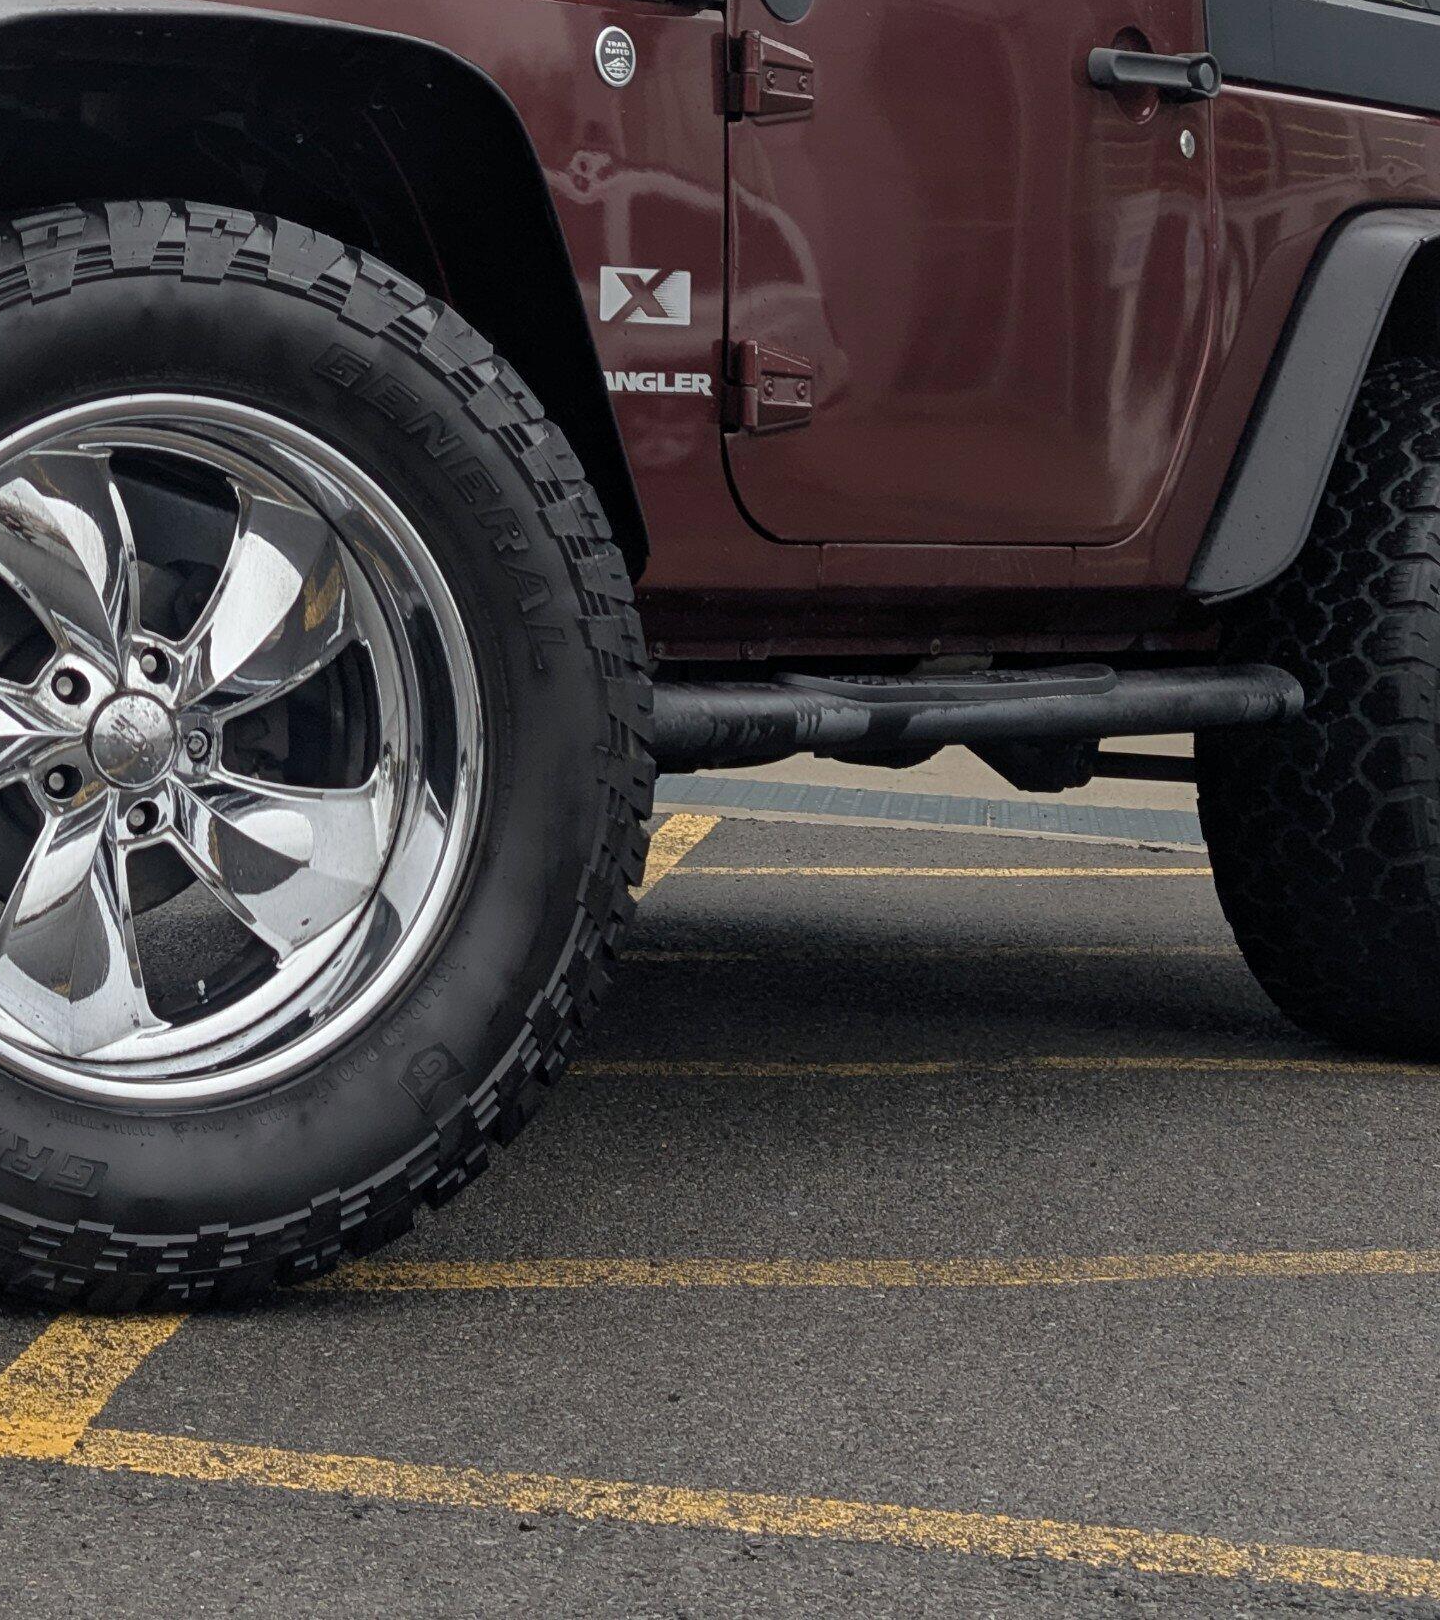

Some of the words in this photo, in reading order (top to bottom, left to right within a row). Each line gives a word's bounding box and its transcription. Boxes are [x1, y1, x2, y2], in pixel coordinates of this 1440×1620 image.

[605, 47, 630, 56] RATED
[605, 267, 680, 324] X
[603, 370, 713, 396] ANGLER
[314, 342, 570, 671] GENERAL
